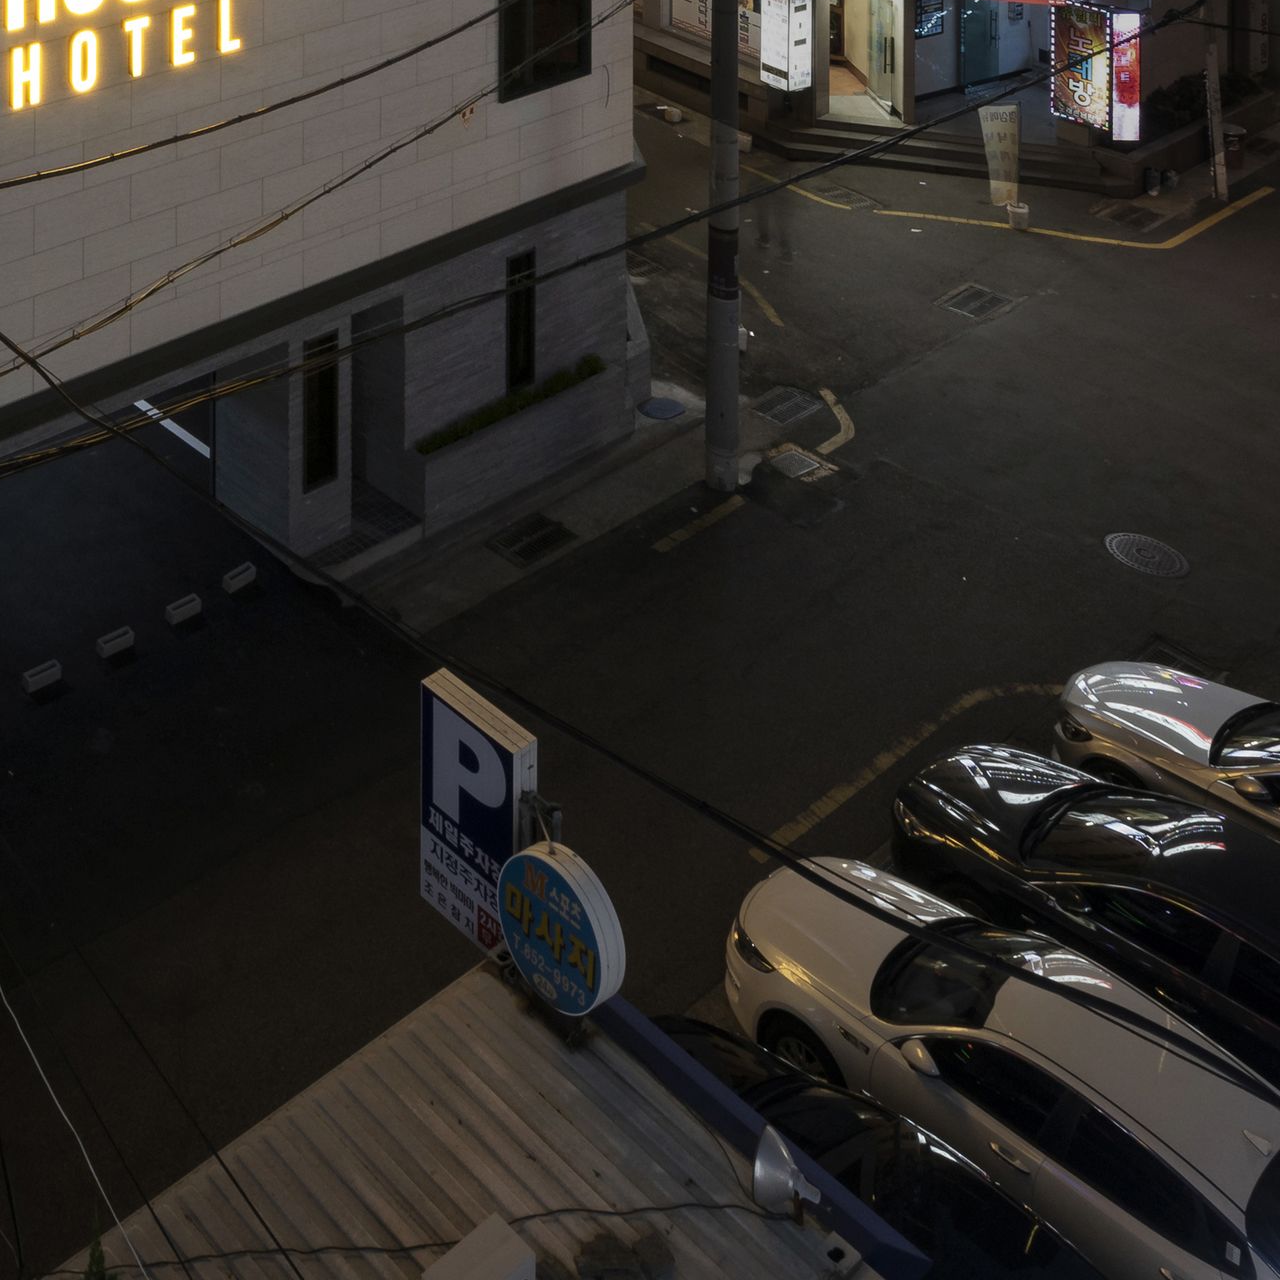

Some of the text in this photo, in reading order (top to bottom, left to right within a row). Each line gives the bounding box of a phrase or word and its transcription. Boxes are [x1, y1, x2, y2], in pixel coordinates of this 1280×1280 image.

[432, 695, 507, 826] P
[504, 881, 597, 994] 마사지
[523, 861, 583, 930] M 스포츠
